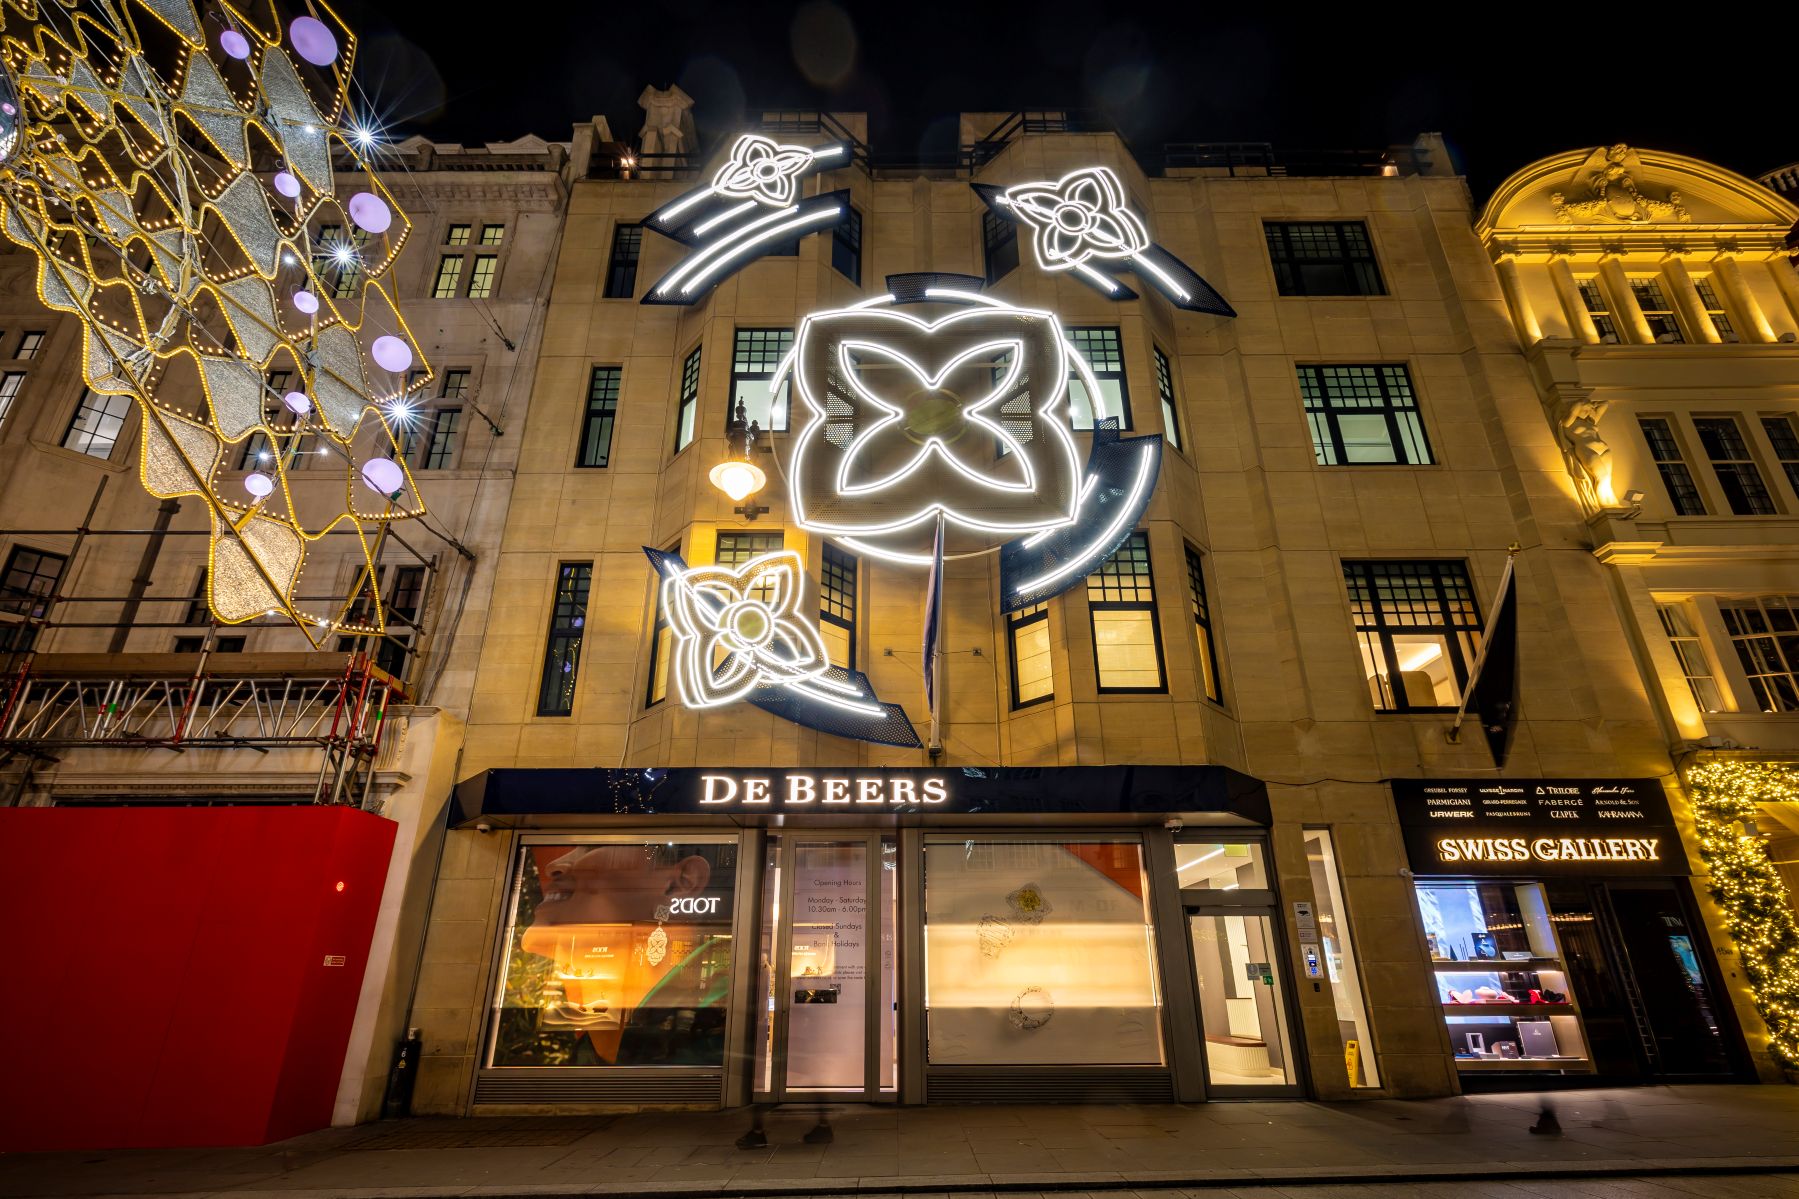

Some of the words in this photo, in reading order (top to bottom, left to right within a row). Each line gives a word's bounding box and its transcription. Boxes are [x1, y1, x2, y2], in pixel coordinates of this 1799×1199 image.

[699, 775, 770, 804] DE
[784, 775, 948, 804] BEERS
[1438, 838, 1530, 861] SWISS
[1531, 838, 1660, 861] GALLERY
[813, 879, 841, 887] Opening
[807, 896, 834, 904] Monday
[807, 905, 837, 913] 10.30am
[835, 922, 862, 931] Sundays
[833, 931, 840, 939] &
[832, 940, 860, 949] Holidays
